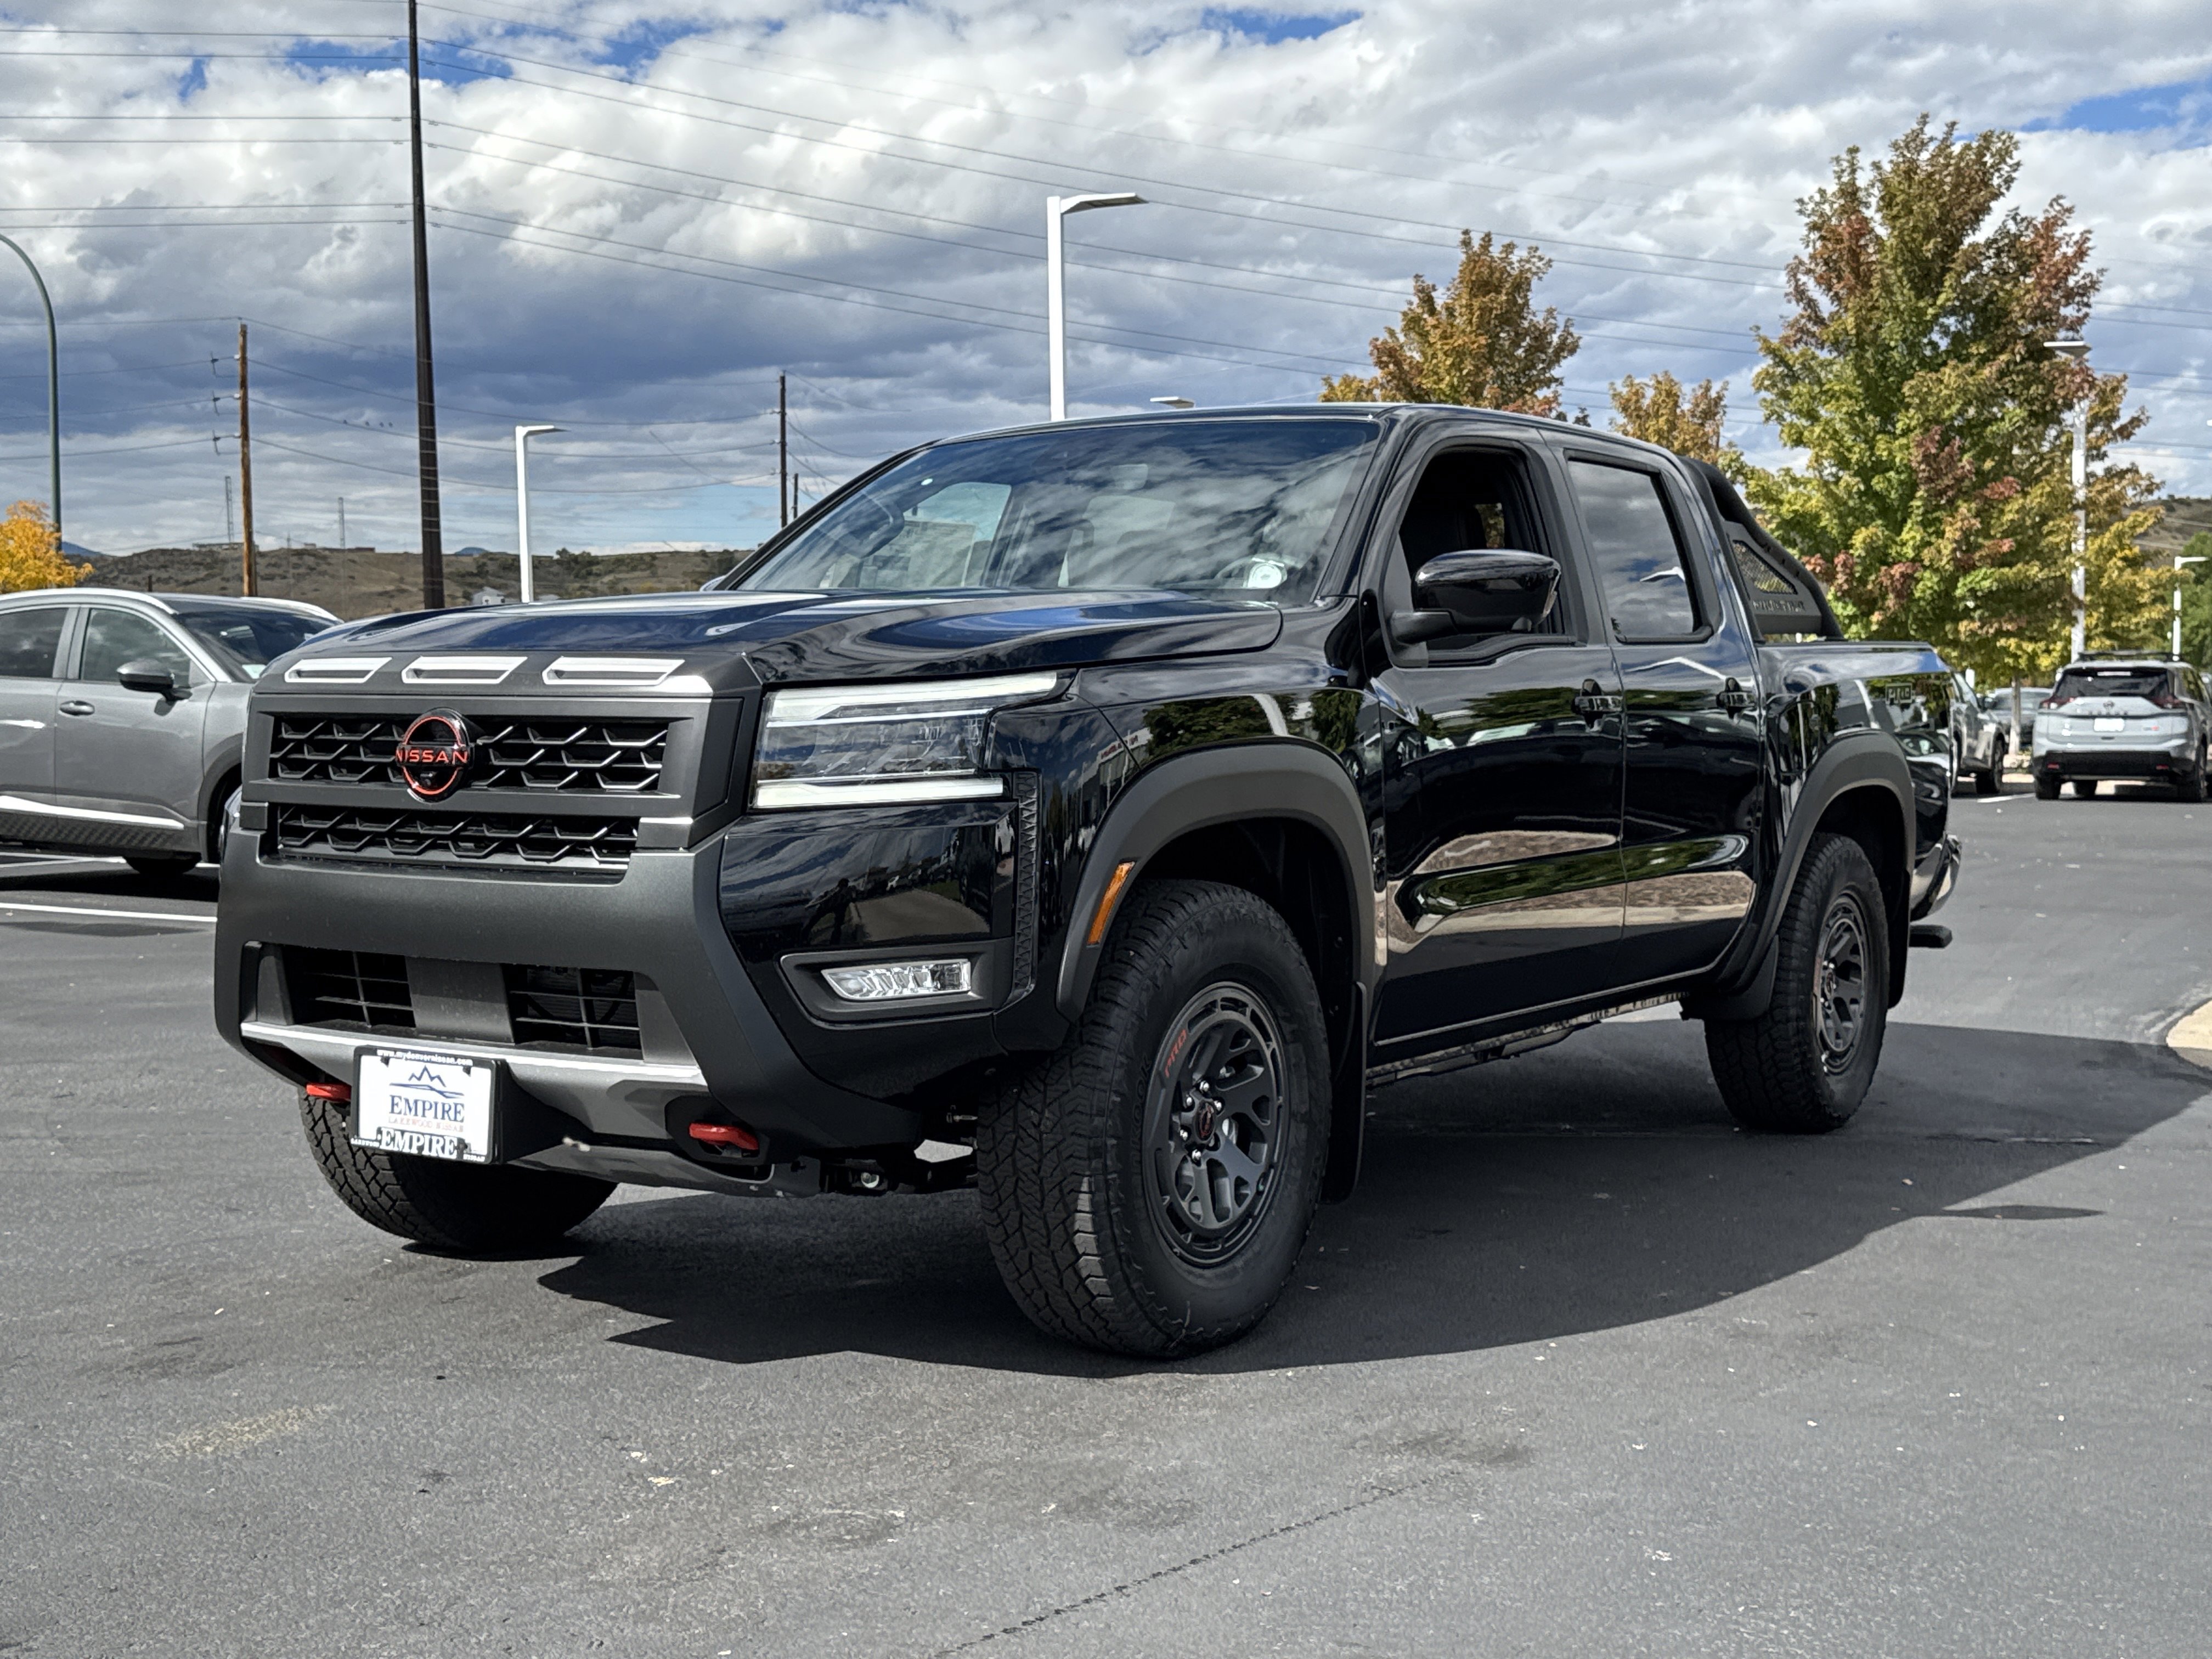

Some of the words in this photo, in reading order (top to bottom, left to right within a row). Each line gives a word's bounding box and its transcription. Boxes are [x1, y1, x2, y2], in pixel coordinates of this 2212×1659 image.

[396, 749, 468, 765] NISSAN
[389, 1095, 464, 1123] EMPIRE
[388, 1116, 432, 1128] LAKEWOOD
[436, 1122, 464, 1133] NISSAN
[380, 1127, 457, 1159] EMPIRE
